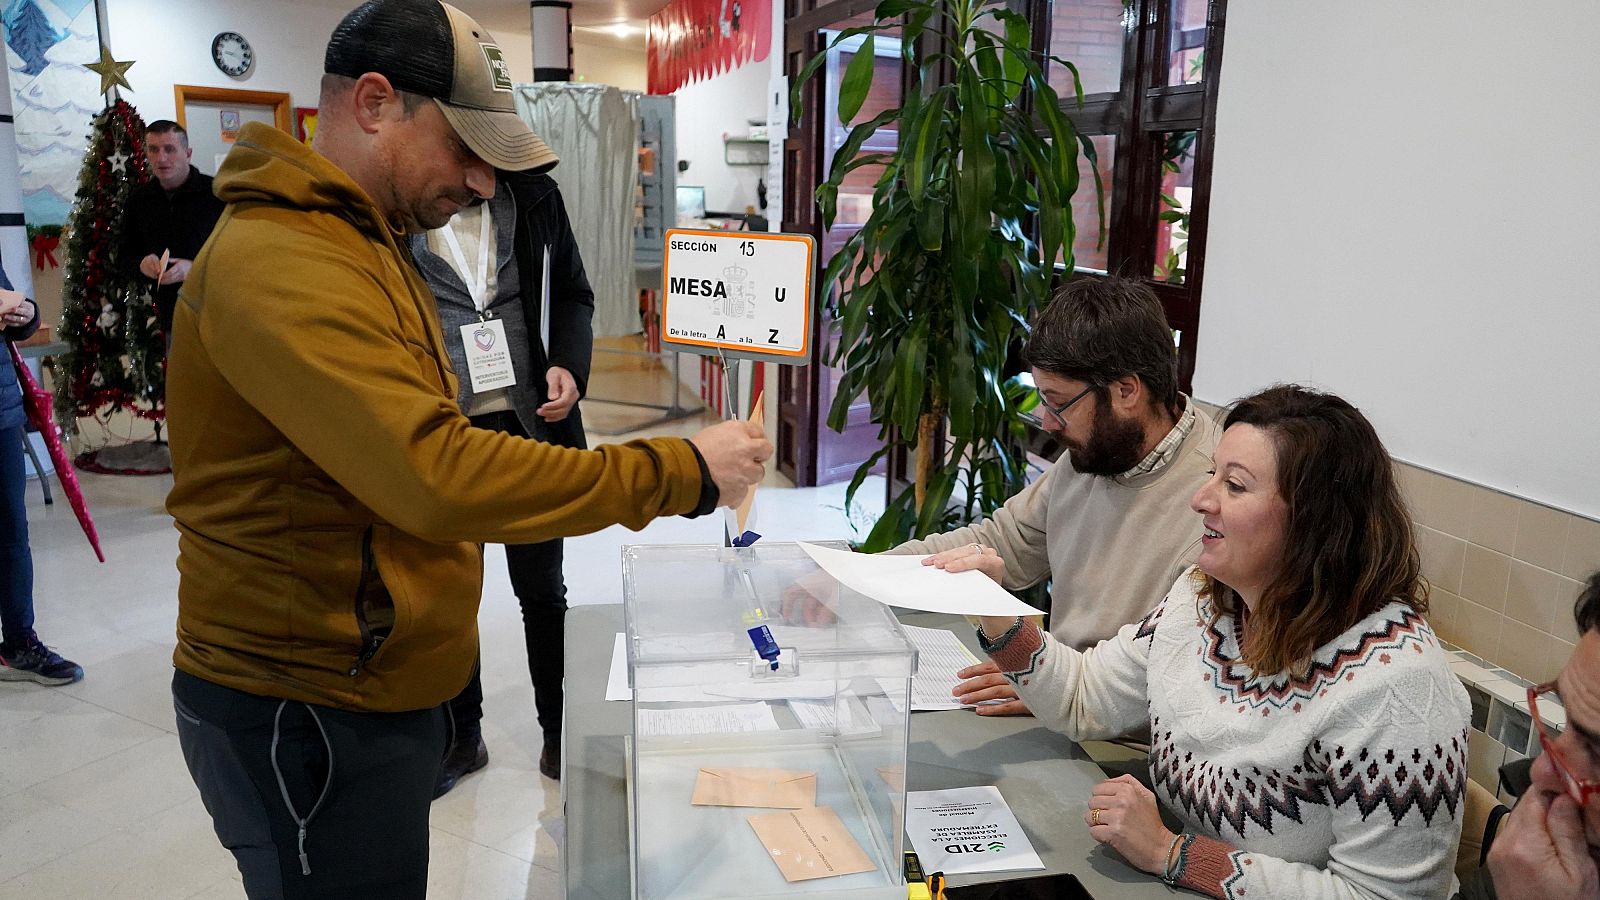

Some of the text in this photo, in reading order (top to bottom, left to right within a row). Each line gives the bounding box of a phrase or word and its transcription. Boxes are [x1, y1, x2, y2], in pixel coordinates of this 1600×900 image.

[671, 240, 755, 257] SECCIÓN 15
[670, 277, 786, 303] MESA U
[670, 328, 680, 336] De
[681, 329, 688, 337] la
[690, 330, 707, 339] letra
[716, 324, 726, 340] A
[745, 336, 753, 344] la
[768, 328, 779, 344] Z
[930, 823, 999, 832] EXTREMADURA
[953, 833, 1008, 841] ELECCIONES
[944, 844, 986, 854] 21D
